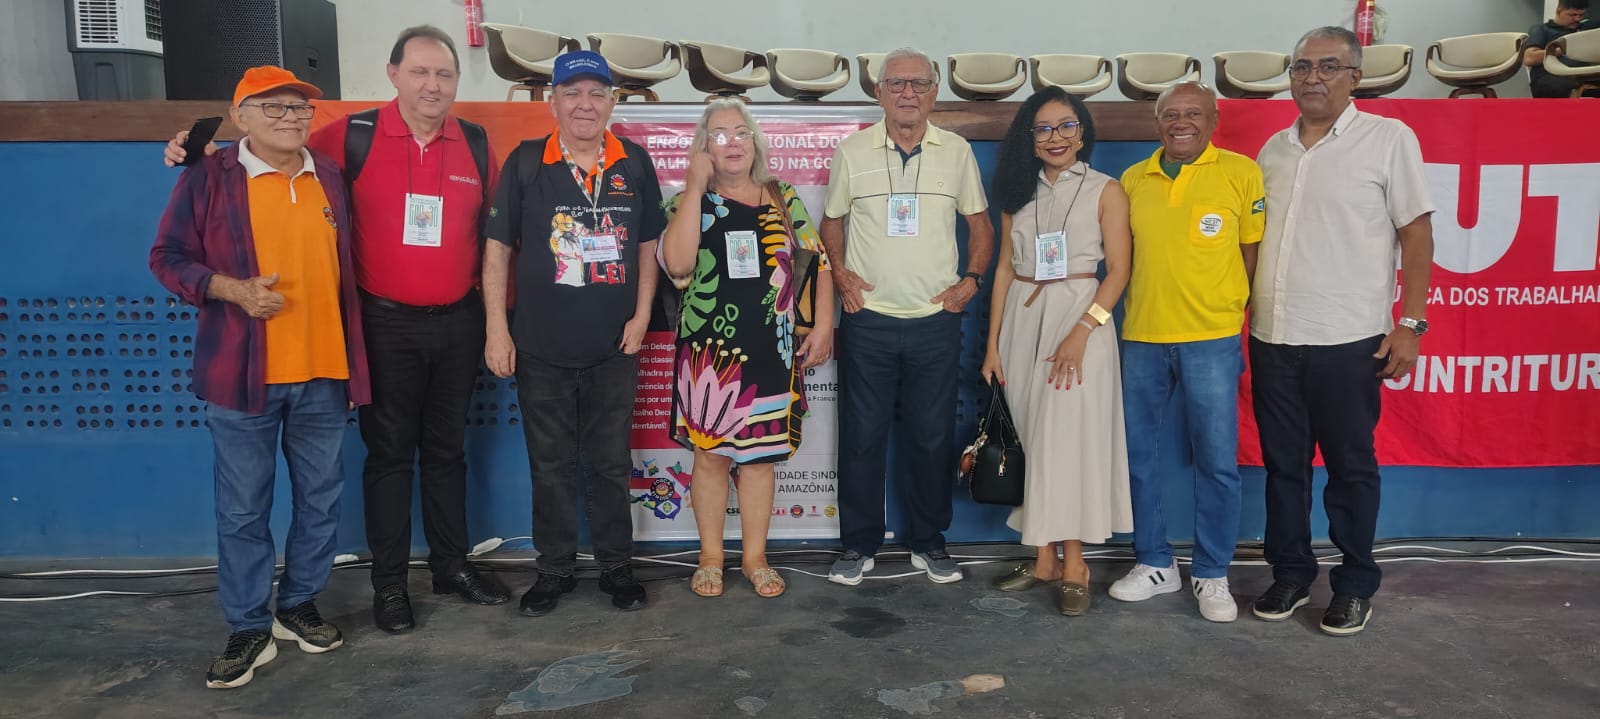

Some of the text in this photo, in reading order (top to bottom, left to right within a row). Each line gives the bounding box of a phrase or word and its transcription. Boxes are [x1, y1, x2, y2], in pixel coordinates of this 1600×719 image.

[652, 157, 690, 170] ALH
[766, 157, 784, 172] S)
[788, 157, 810, 170] NA
[1449, 287, 1490, 306] DOS
[651, 356, 673, 364] classe
[777, 482, 835, 493] AMAZÔNIA
